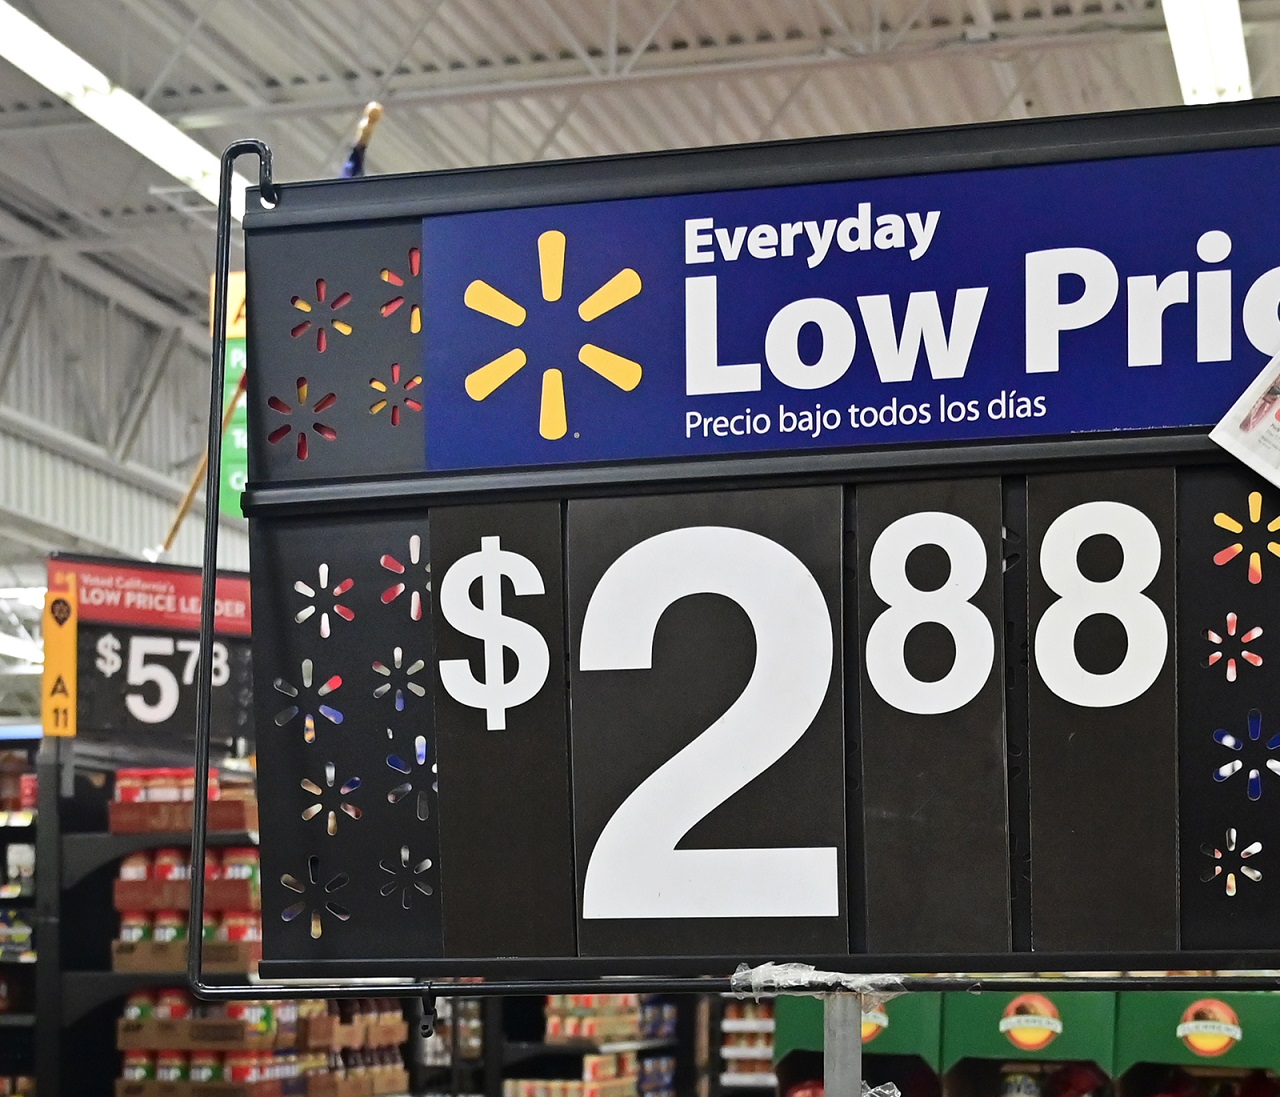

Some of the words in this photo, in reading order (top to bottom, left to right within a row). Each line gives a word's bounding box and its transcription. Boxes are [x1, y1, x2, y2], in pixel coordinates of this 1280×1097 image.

[685, 202, 940, 268] Everyday
[685, 275, 988, 397] Low
[685, 410, 770, 439] Precio
[778, 401, 839, 437] bajo
[849, 396, 932, 429] todos
[939, 392, 980, 423] los
[988, 389, 1047, 420] días
[80, 588, 121, 606] LOW
[124, 592, 176, 611] PRICE
[50, 675, 68, 697] A
[53, 707, 68, 728] 11
